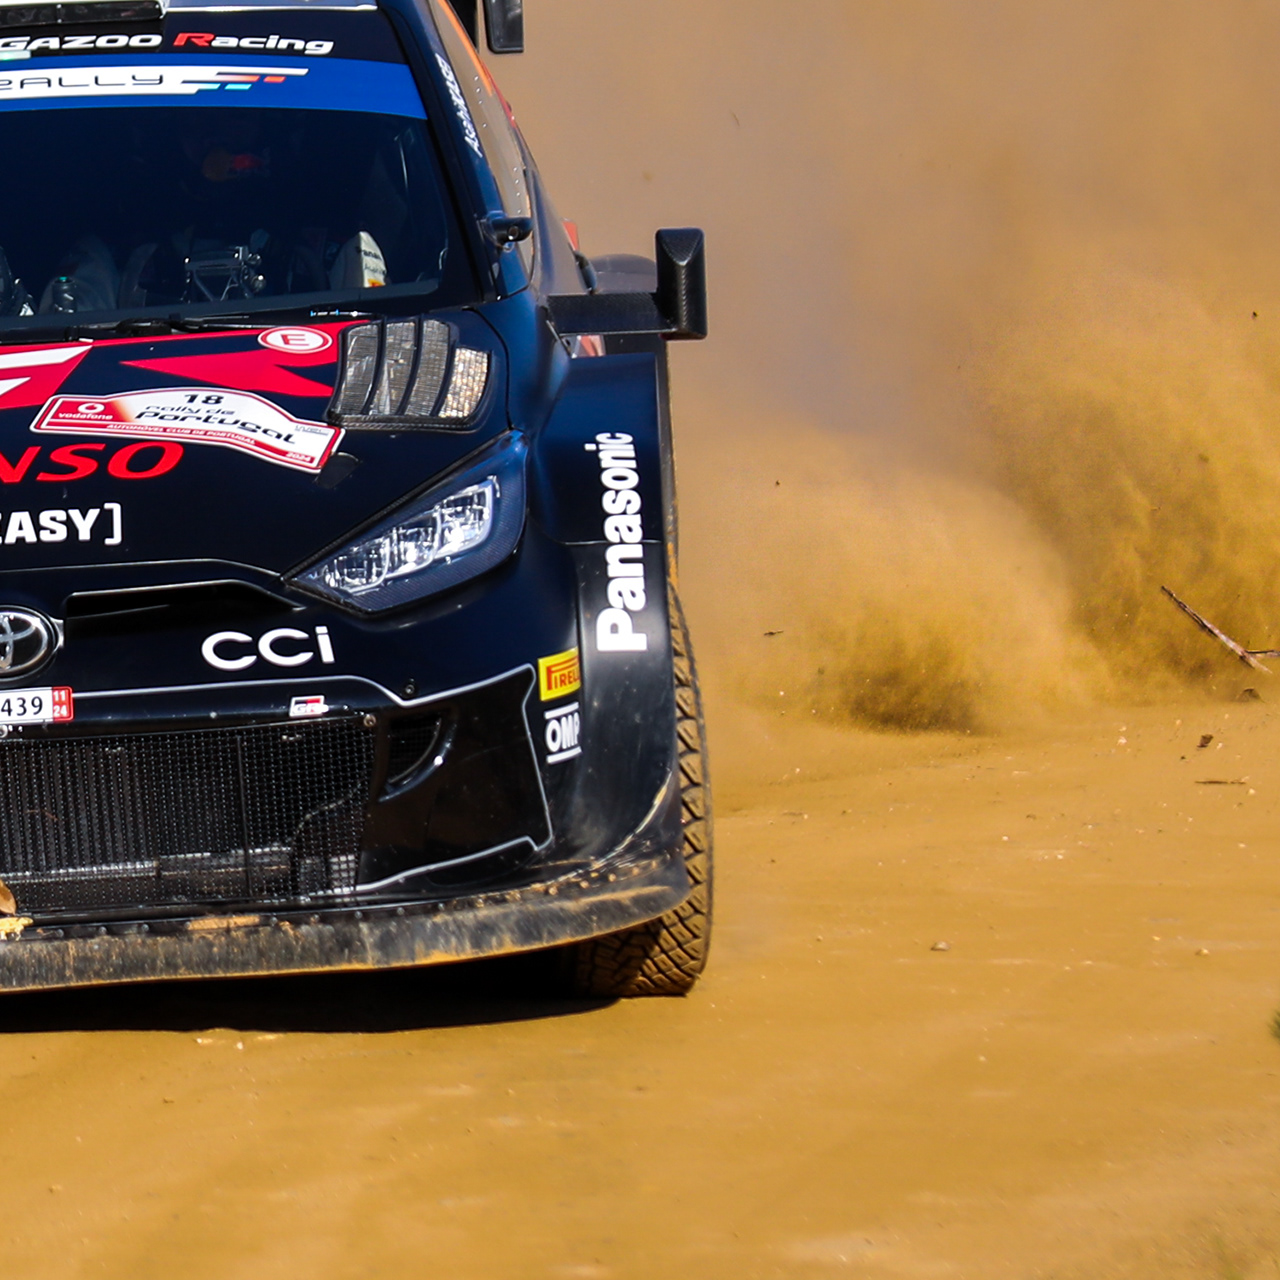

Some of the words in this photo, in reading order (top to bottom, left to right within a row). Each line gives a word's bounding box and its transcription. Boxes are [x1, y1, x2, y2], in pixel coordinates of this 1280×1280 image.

[173, 32, 335, 55] Racing
[281, 332, 310, 346] E
[183, 393, 225, 405] 18
[58, 412, 114, 421] vodafone
[206, 431, 256, 446] PORTUGAL
[285, 452, 312, 463] 2024
[584, 432, 648, 652] Panasonic
[53, 690, 66, 702] 11
[53, 705, 68, 717] 24
[545, 711, 580, 753] OMP
